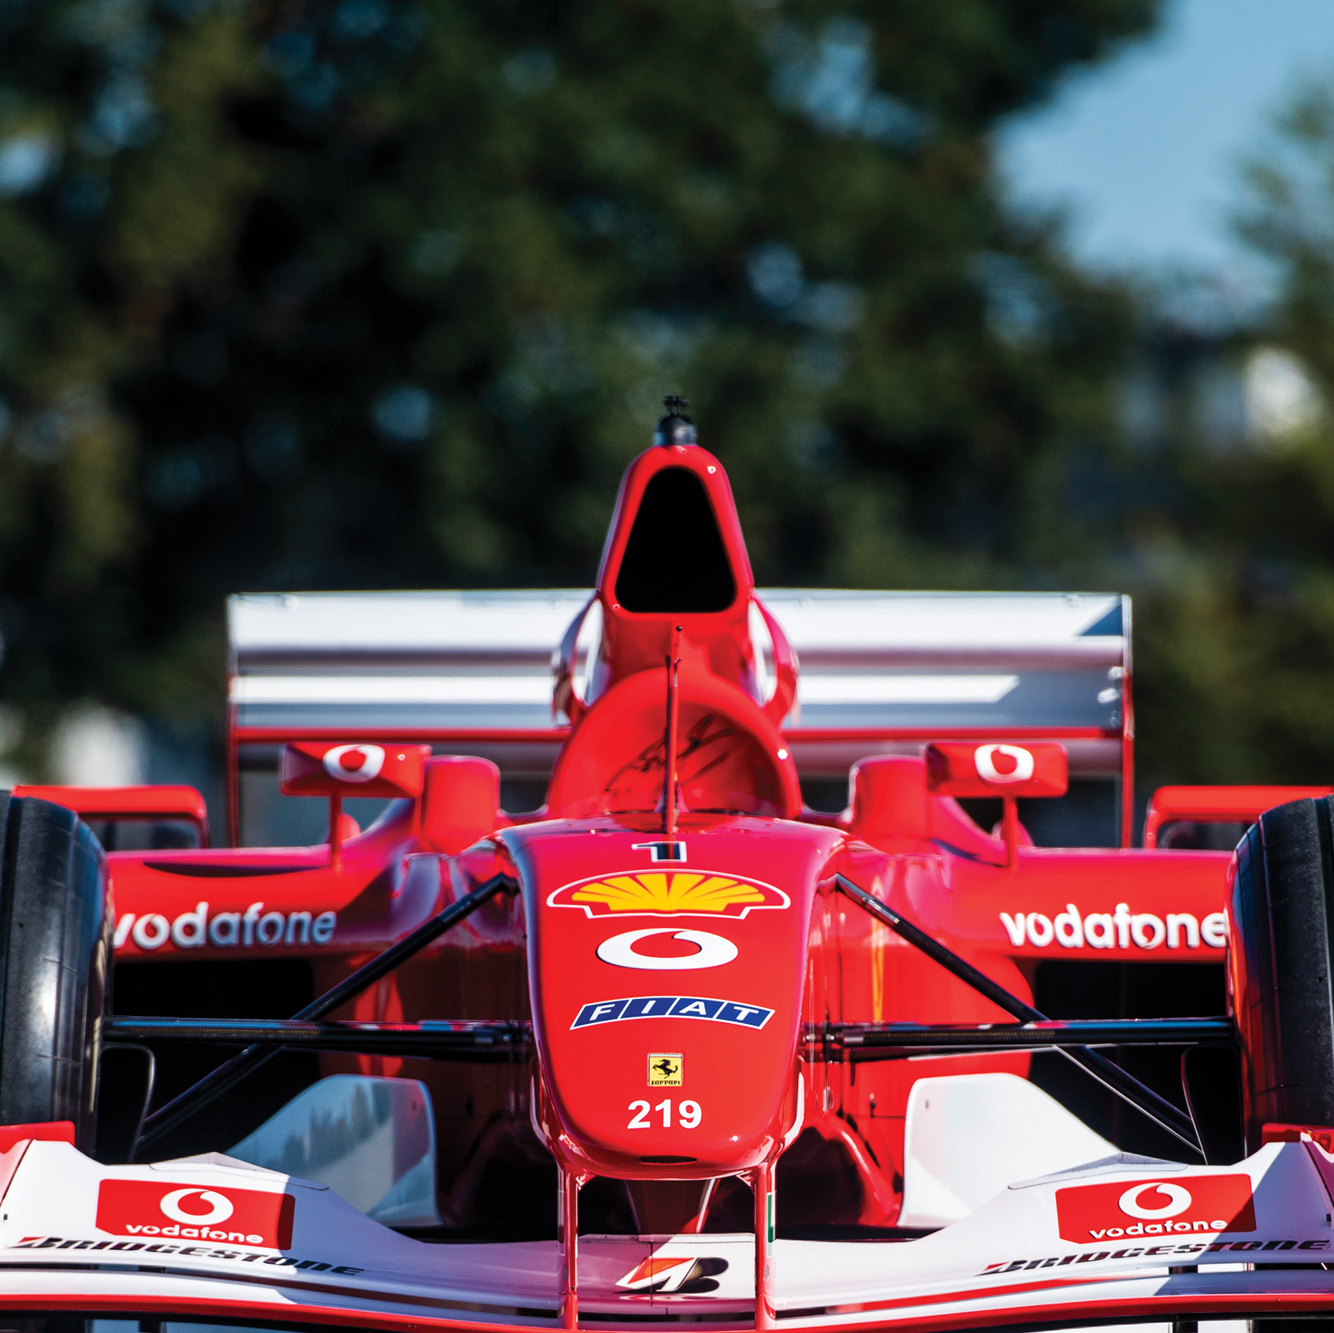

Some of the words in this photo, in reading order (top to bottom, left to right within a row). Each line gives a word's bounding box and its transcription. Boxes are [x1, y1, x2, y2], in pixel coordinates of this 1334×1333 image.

[999, 903, 1227, 949] vodafone
[588, 999, 761, 1022] FIAT
[627, 1099, 702, 1129] 219
[126, 1224, 264, 1244] vodafone
[1089, 1219, 1228, 1239] vodafone
[7, 1236, 369, 1276] BRIDGESTONE
[974, 1239, 1331, 1276] BRIDGESTONE
